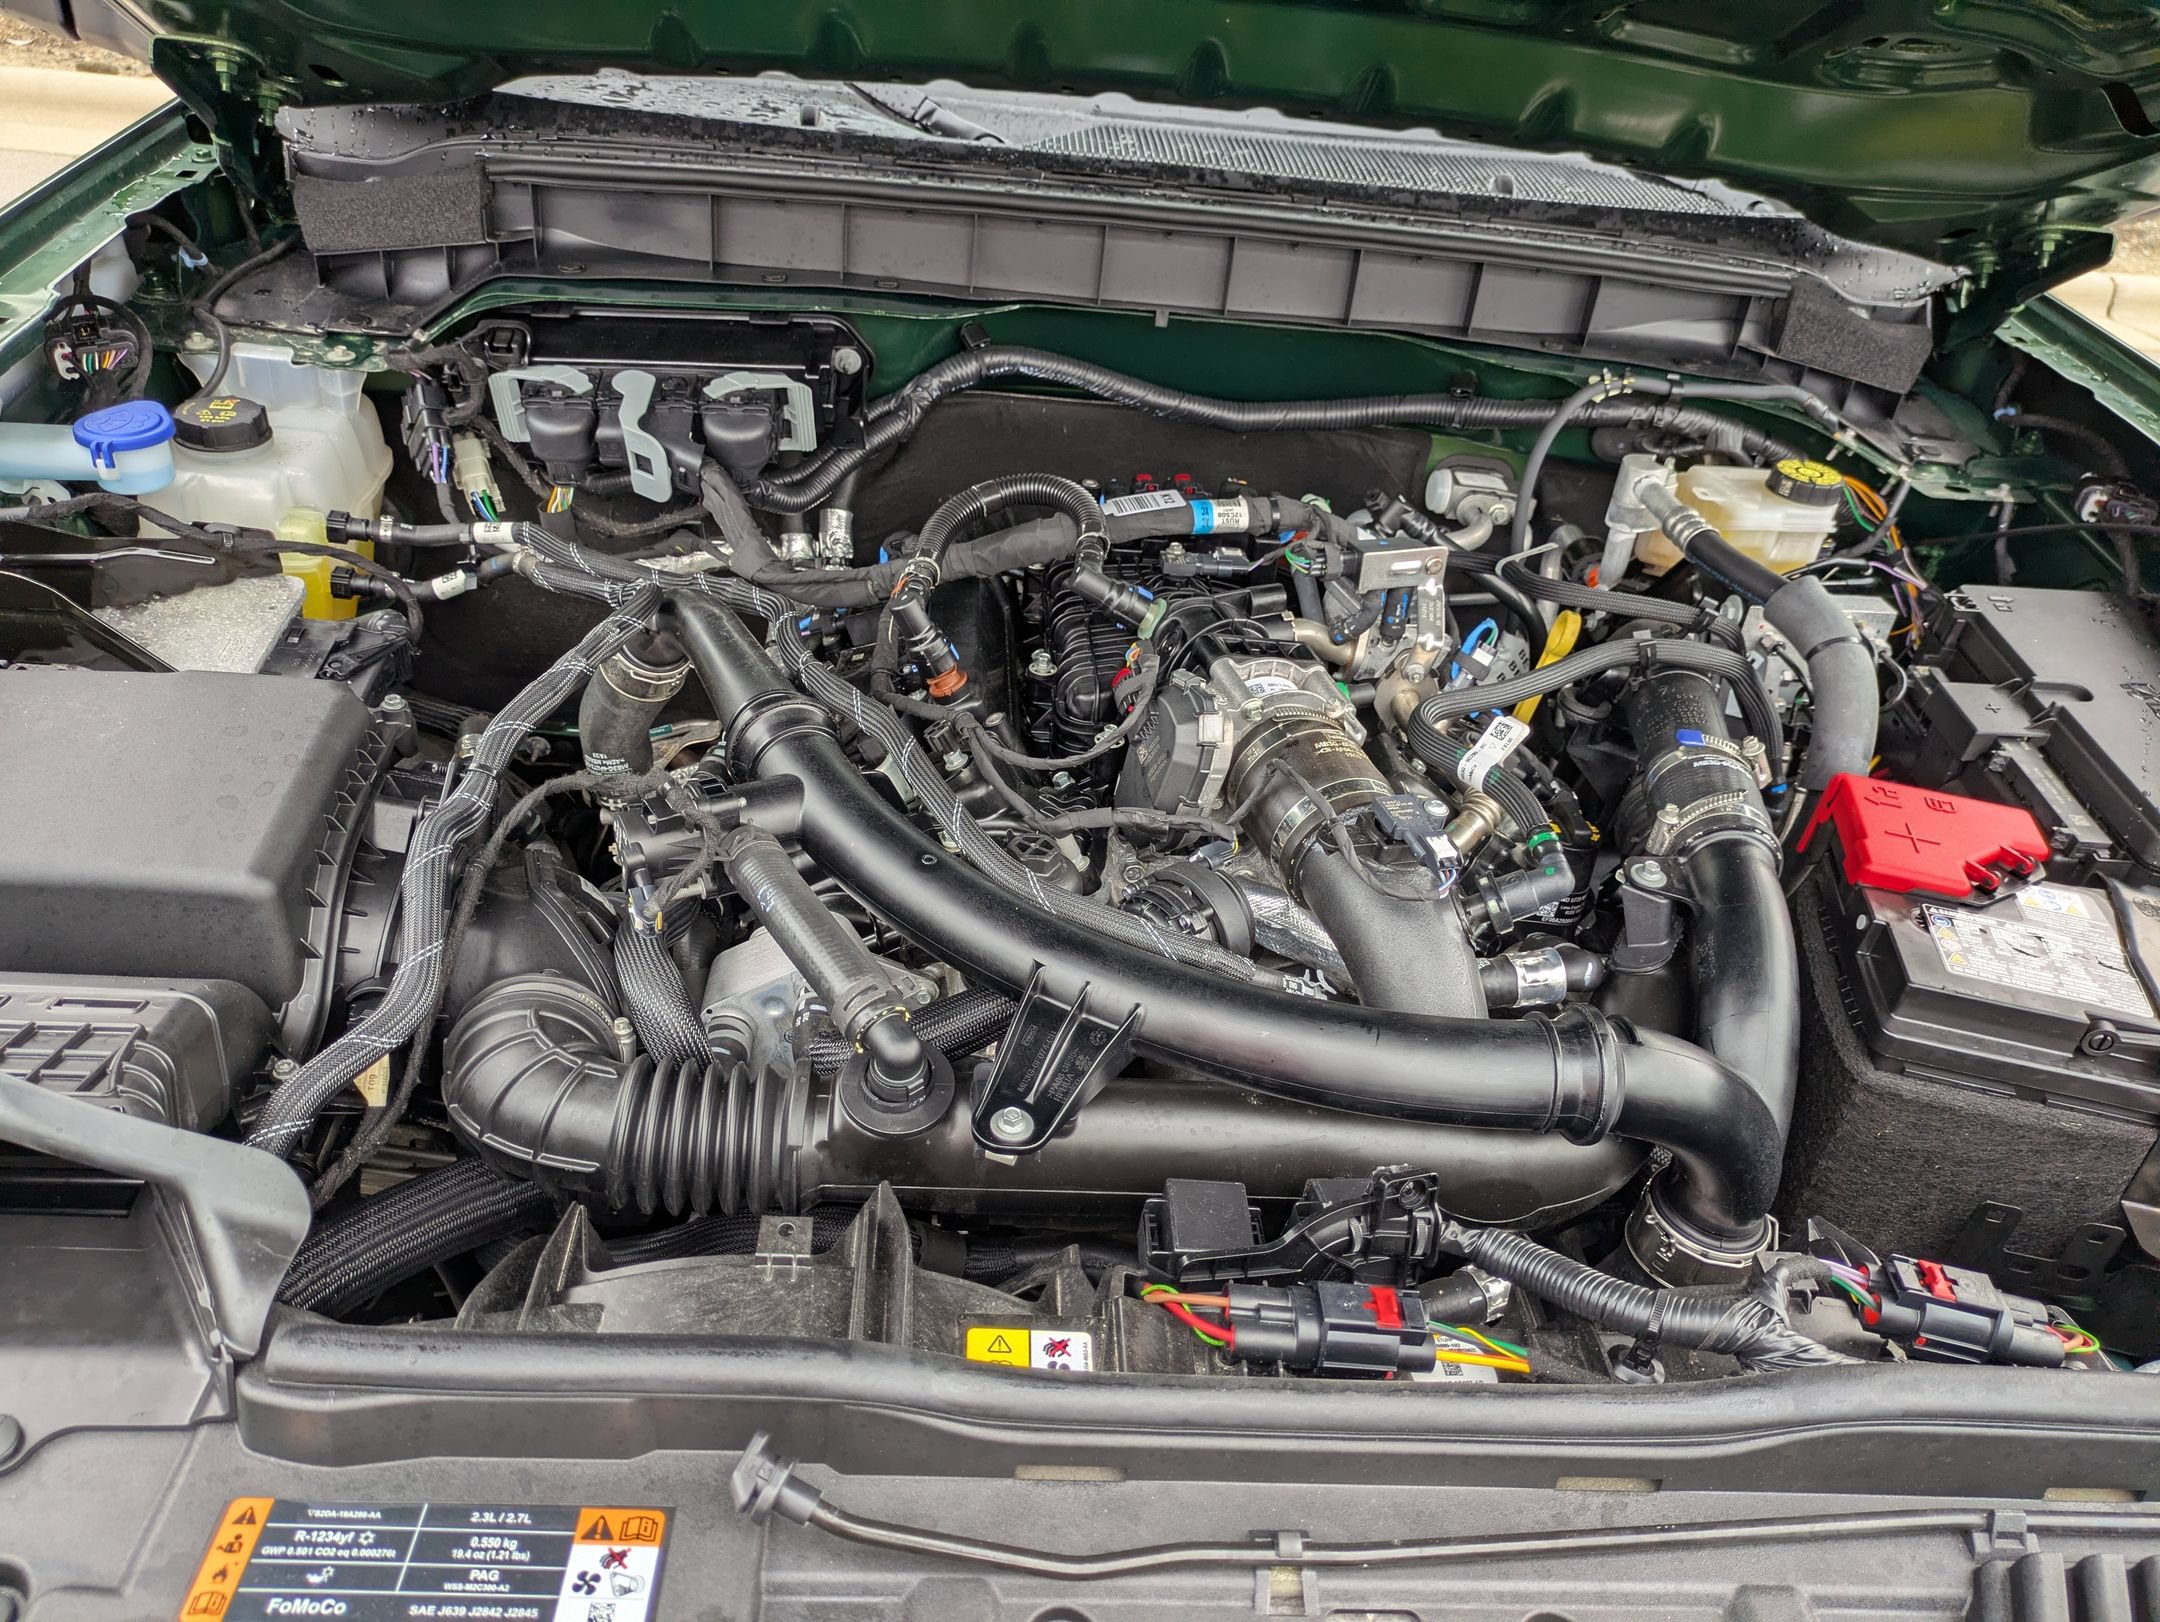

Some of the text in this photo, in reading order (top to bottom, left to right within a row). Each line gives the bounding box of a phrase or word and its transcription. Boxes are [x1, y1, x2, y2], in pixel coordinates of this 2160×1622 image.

[470, 1512, 532, 1524] 2.3L / 2.7L
[294, 1529, 356, 1545] R-1234yf
[470, 1536, 518, 1551] 0.550 kg
[261, 1546, 286, 1556] GWP
[286, 1546, 312, 1557] 0.501
[314, 1547, 337, 1557] CO2
[337, 1550, 350, 1559] eq
[452, 1548, 531, 1562] 19.4 oz (1.21 lbs)
[469, 1569, 500, 1581] PAG
[443, 1582, 511, 1593] WSS-M2C300-A2
[266, 1597, 347, 1616] FoMoCo
[409, 1605, 540, 1619] SAE J639 J2842 J2845
